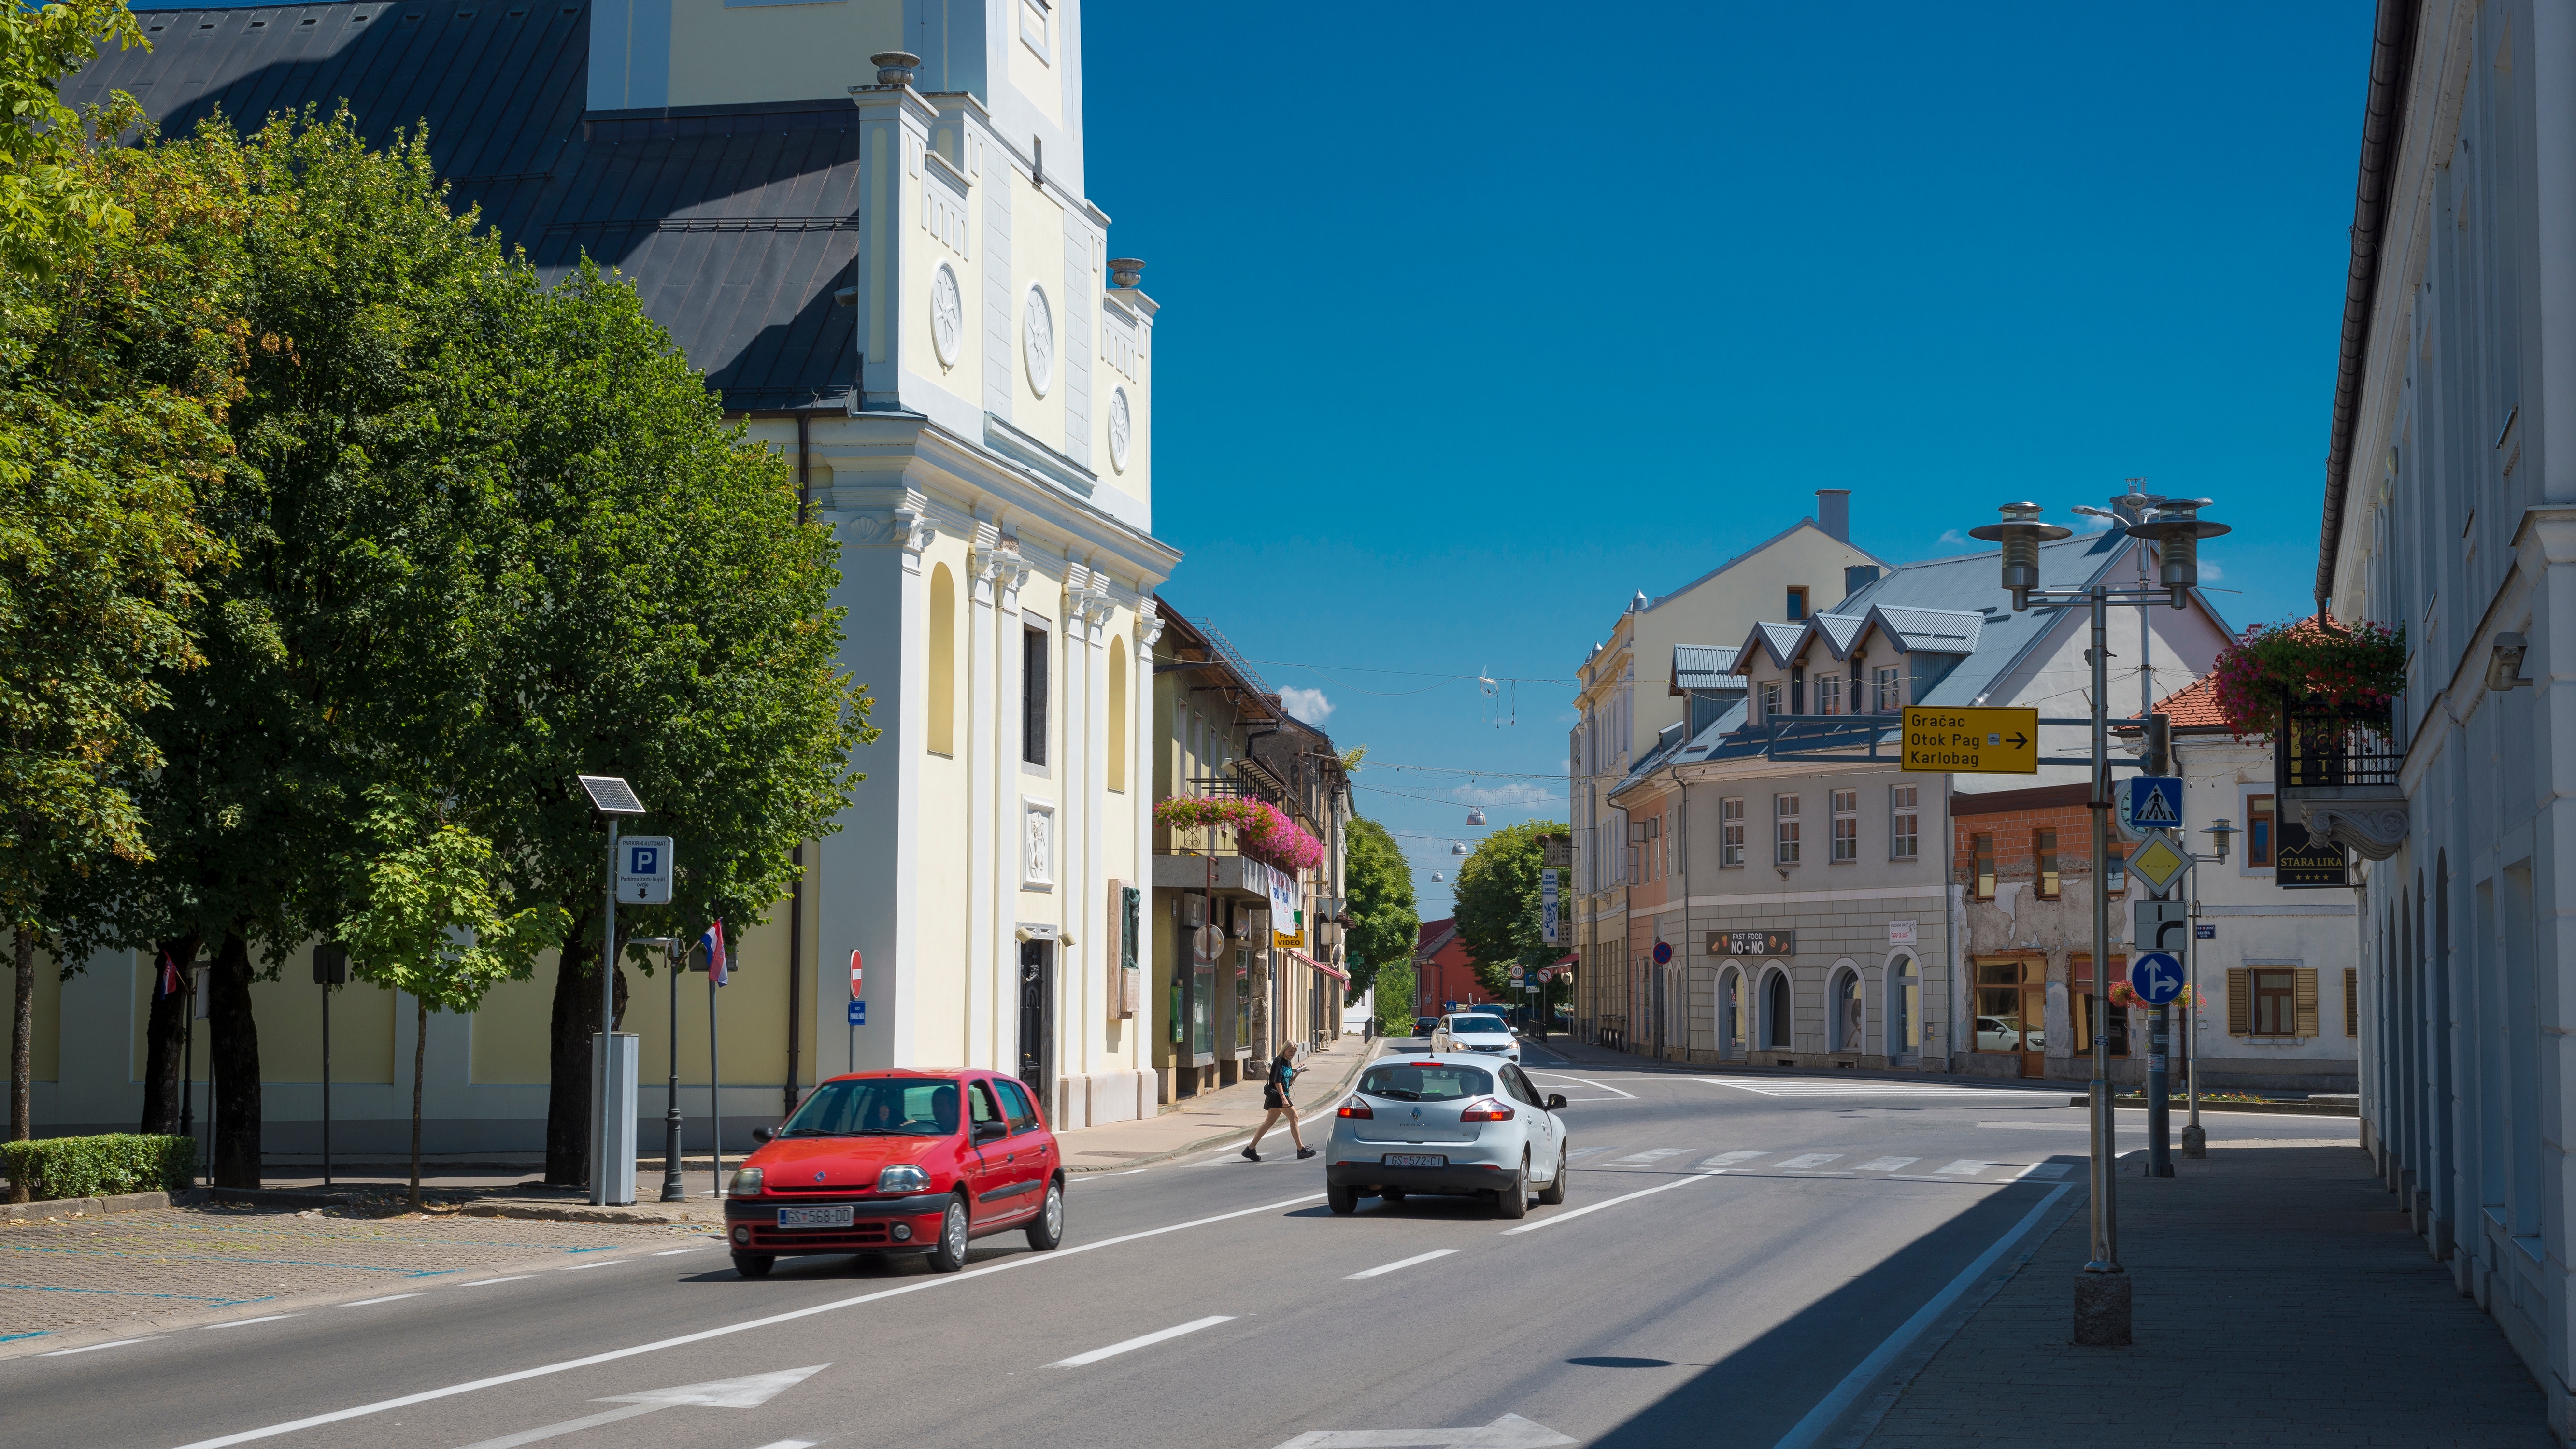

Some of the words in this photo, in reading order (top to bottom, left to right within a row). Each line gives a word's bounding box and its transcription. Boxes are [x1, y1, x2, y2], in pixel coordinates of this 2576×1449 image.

[1911, 714, 1965, 727] Gračac
[1911, 733, 1946, 746] Otok
[1952, 734, 1979, 750] Pag
[1911, 751, 1978, 768] Karlobag
[638, 851, 653, 871] P
[2281, 857, 2315, 866] STARA
[2317, 857, 2343, 866] LIKA
[1731, 940, 1743, 954] NO
[1751, 940, 1764, 954] NO
[1392, 1156, 1402, 1165] GS
[1409, 1156, 1440, 1165] 572-CI
[788, 1211, 801, 1222] GS
